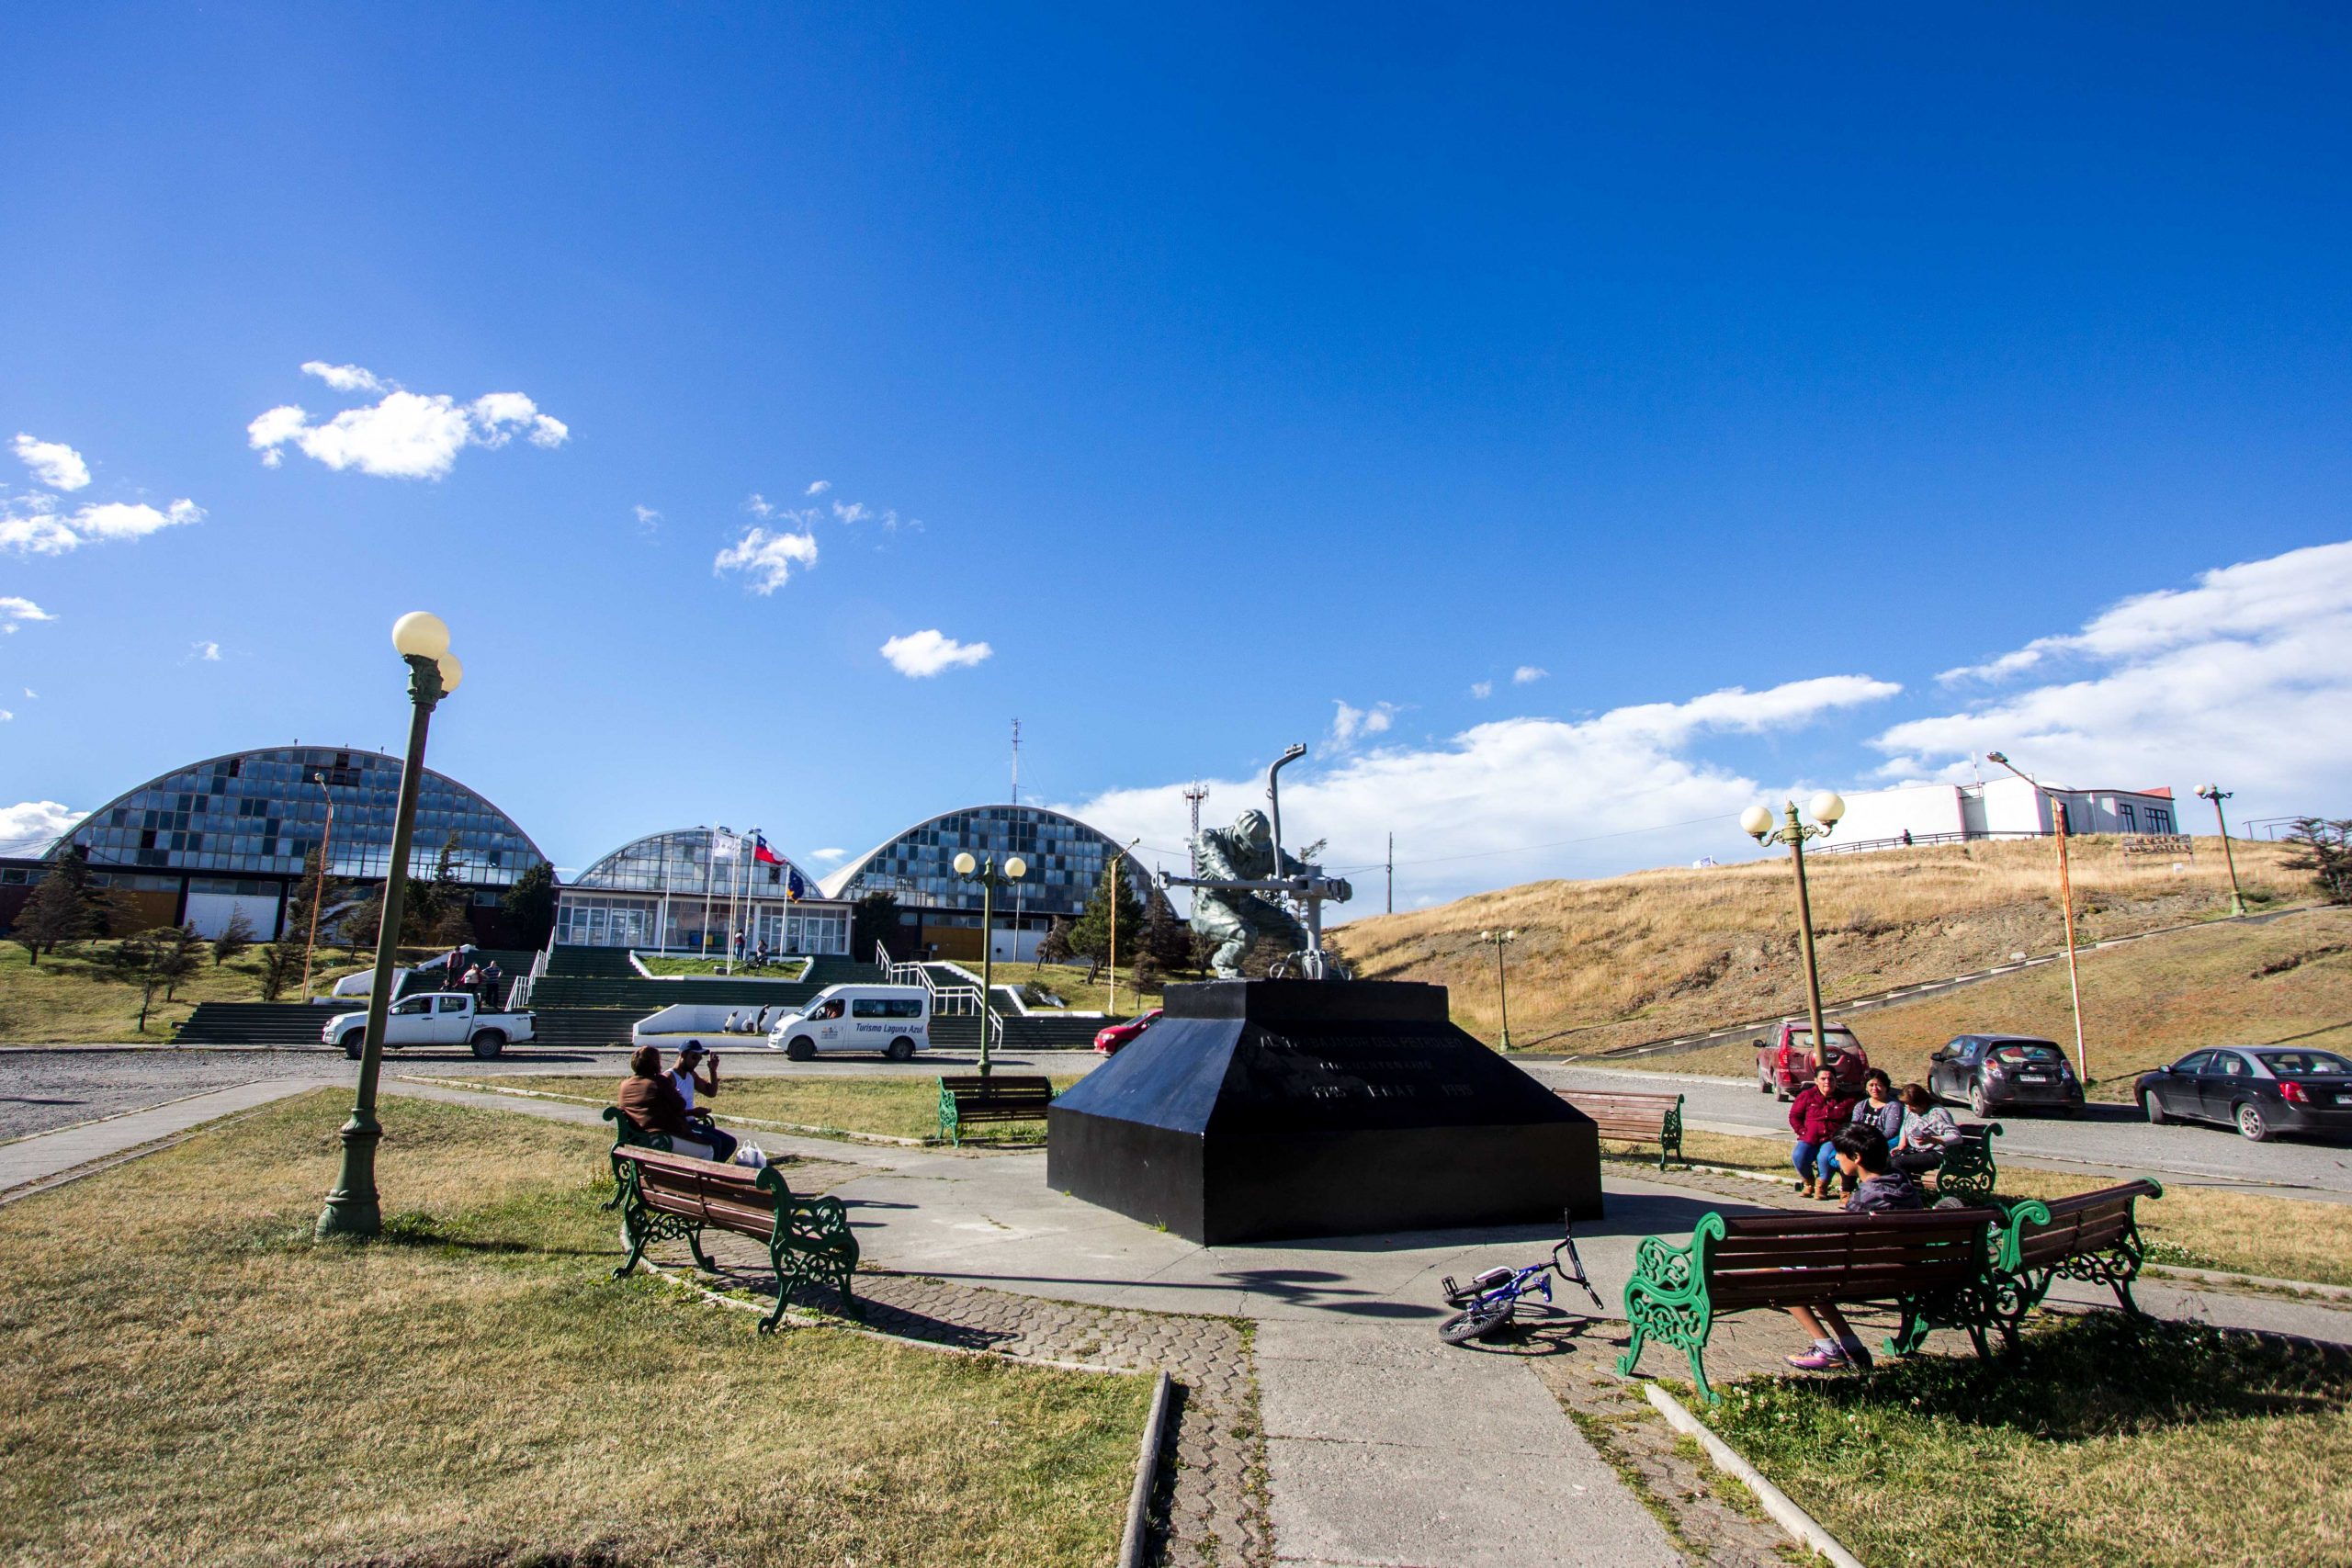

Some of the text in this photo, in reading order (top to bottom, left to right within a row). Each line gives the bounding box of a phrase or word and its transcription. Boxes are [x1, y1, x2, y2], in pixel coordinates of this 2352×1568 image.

[856, 1022, 923, 1034] Turismo Laguna Azul
[1366, 1084, 1417, 1099] ENAP
